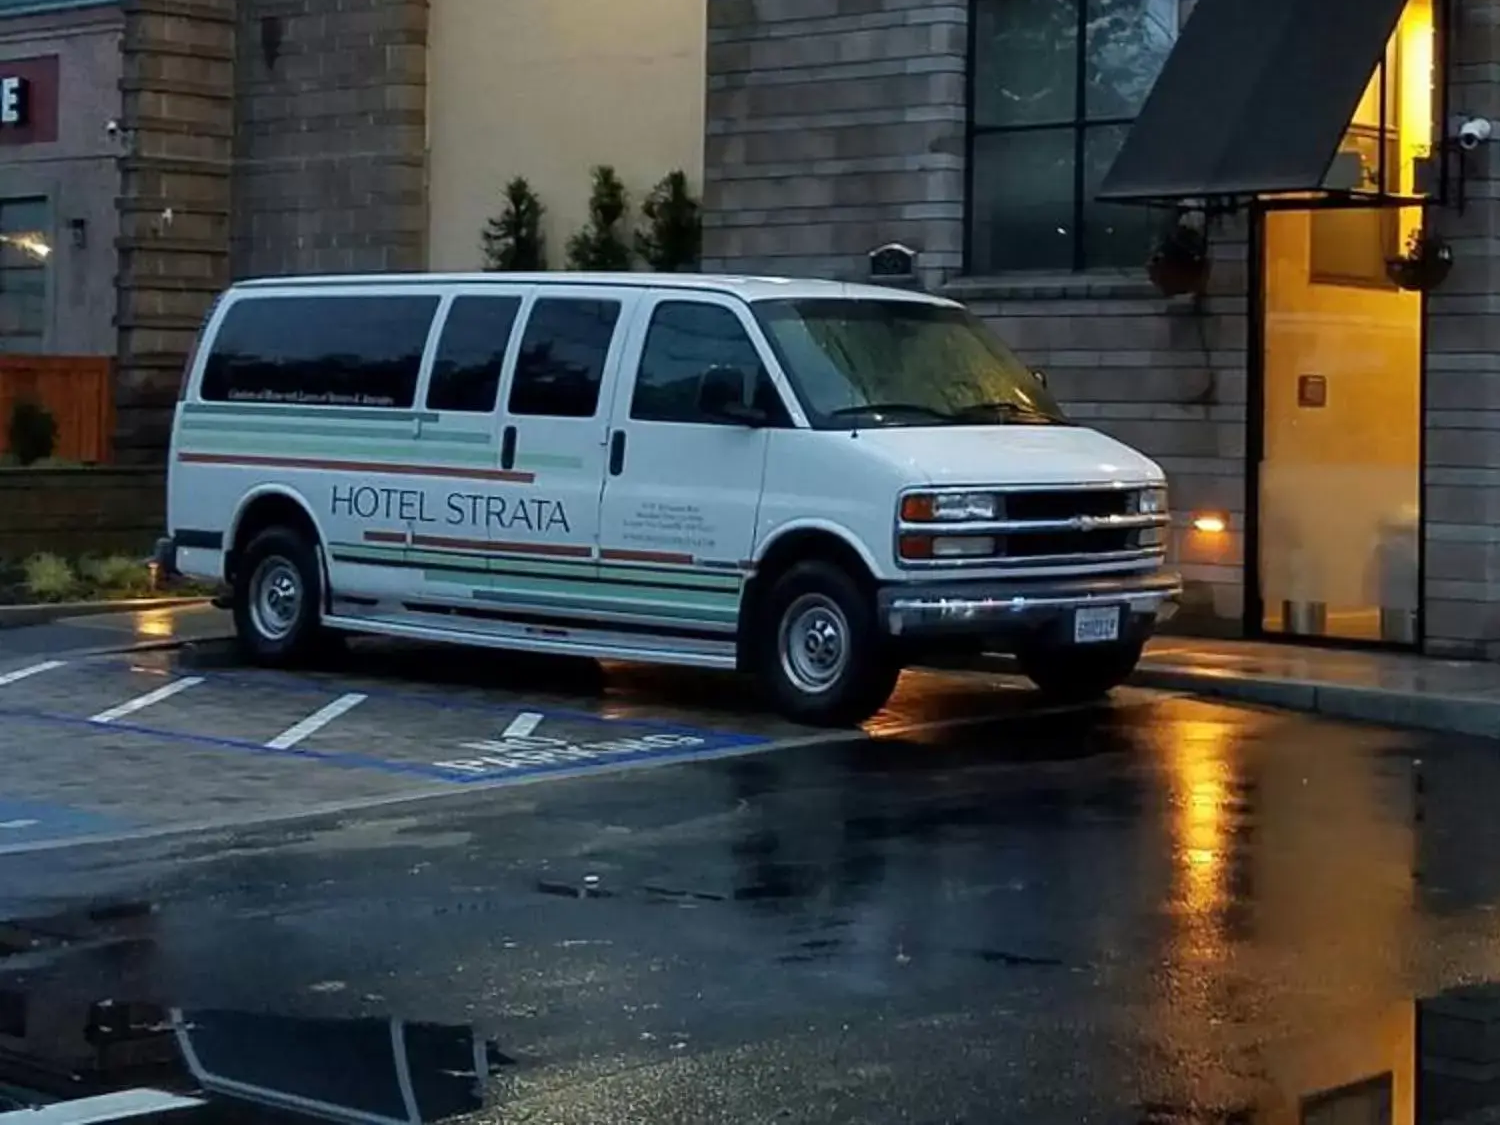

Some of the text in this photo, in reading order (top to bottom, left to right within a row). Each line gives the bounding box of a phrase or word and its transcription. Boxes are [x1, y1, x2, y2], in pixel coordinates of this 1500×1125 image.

[331, 484, 571, 534] HOTEL STRATA
[433, 734, 705, 773] PARKING
